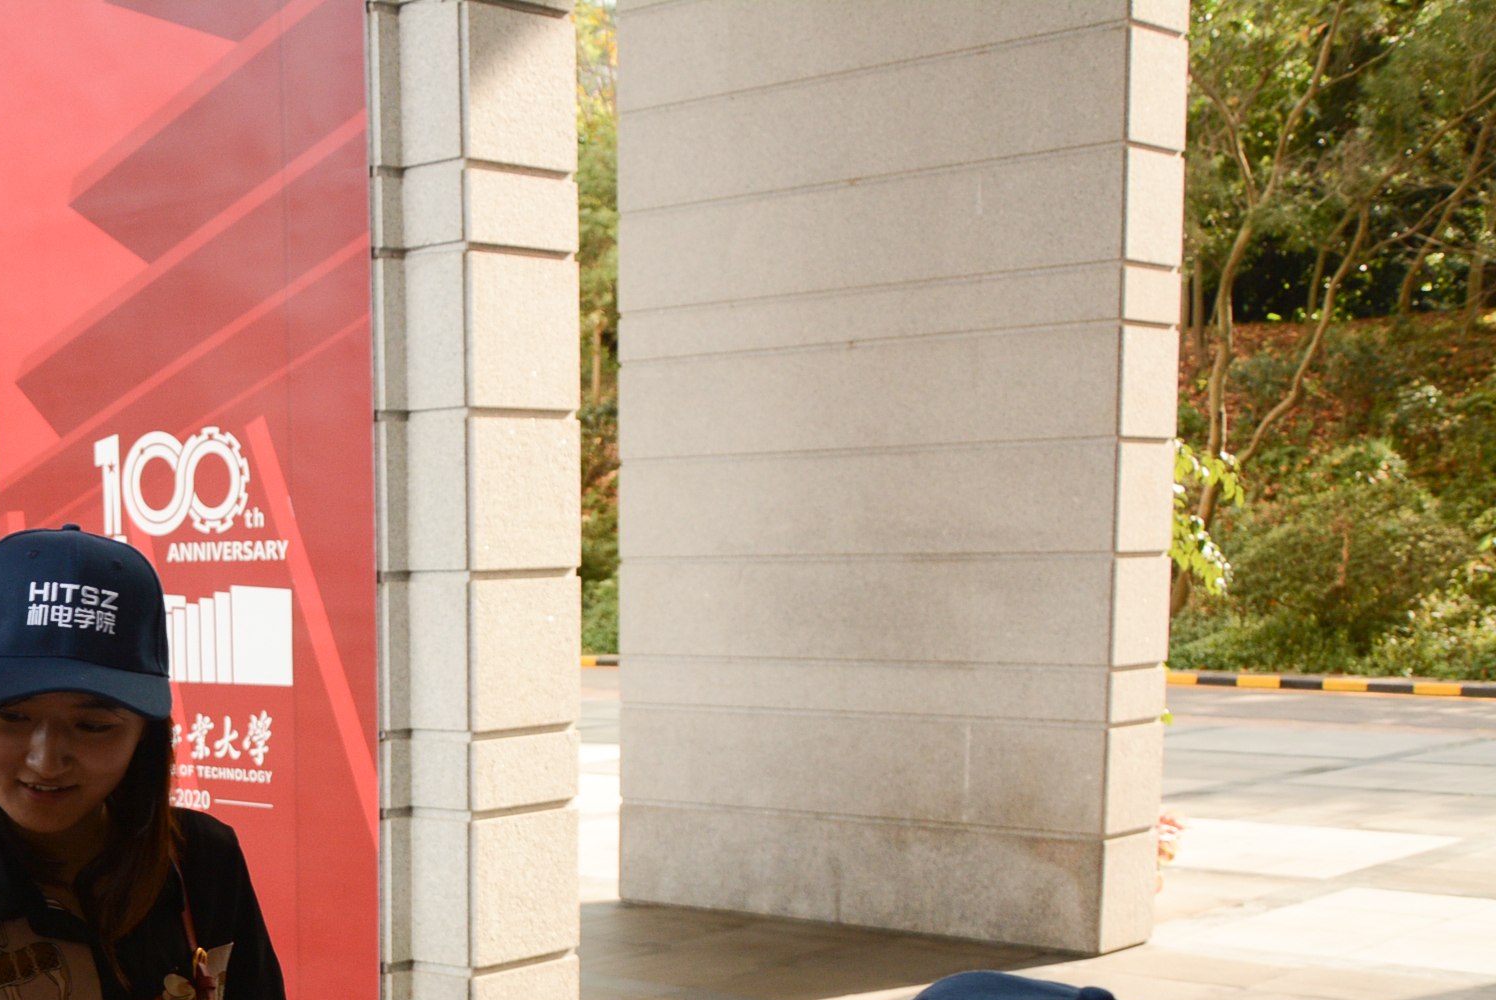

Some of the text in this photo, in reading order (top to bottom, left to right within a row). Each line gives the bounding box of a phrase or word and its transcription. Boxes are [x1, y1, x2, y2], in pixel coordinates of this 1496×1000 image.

[166, 539, 289, 563] ANNIVERSARY
[29, 581, 119, 611] HITSZ
[26, 603, 116, 635] 机电学院
[178, 764, 195, 777] OF
[196, 765, 273, 783] TECHNOLOGY
[169, 788, 211, 810] -2020
